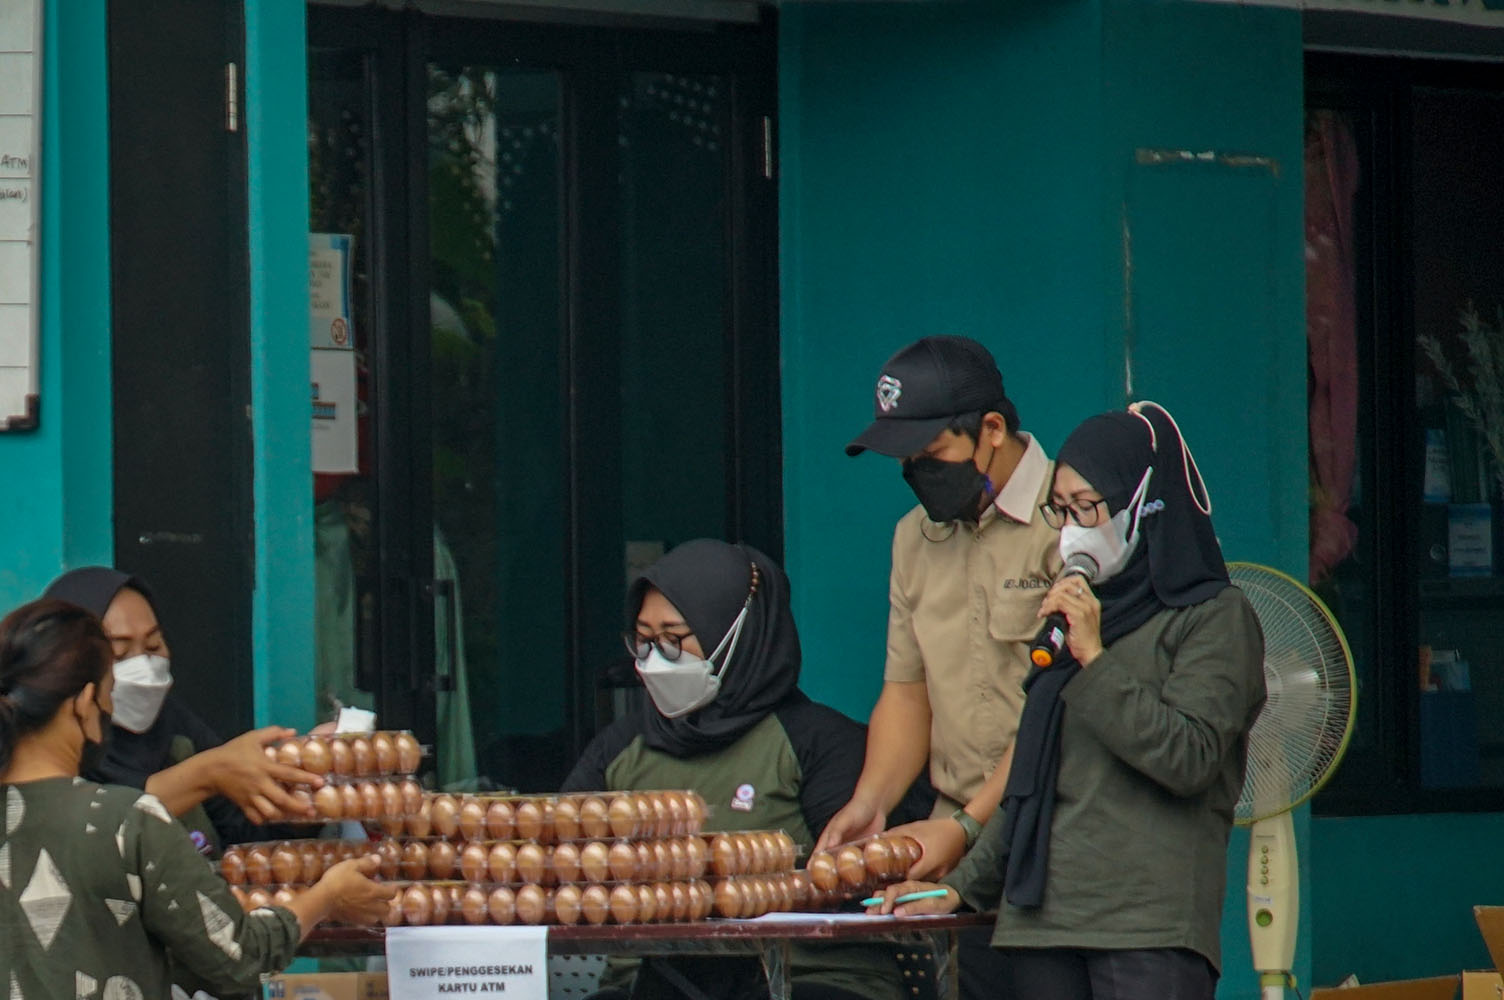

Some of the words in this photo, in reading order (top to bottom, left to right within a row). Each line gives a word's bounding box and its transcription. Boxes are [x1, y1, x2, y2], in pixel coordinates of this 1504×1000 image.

[409, 964, 533, 978] SWIPE/PENGGESEKAN
[438, 982, 477, 993] KARTU
[480, 982, 505, 992] ATM
